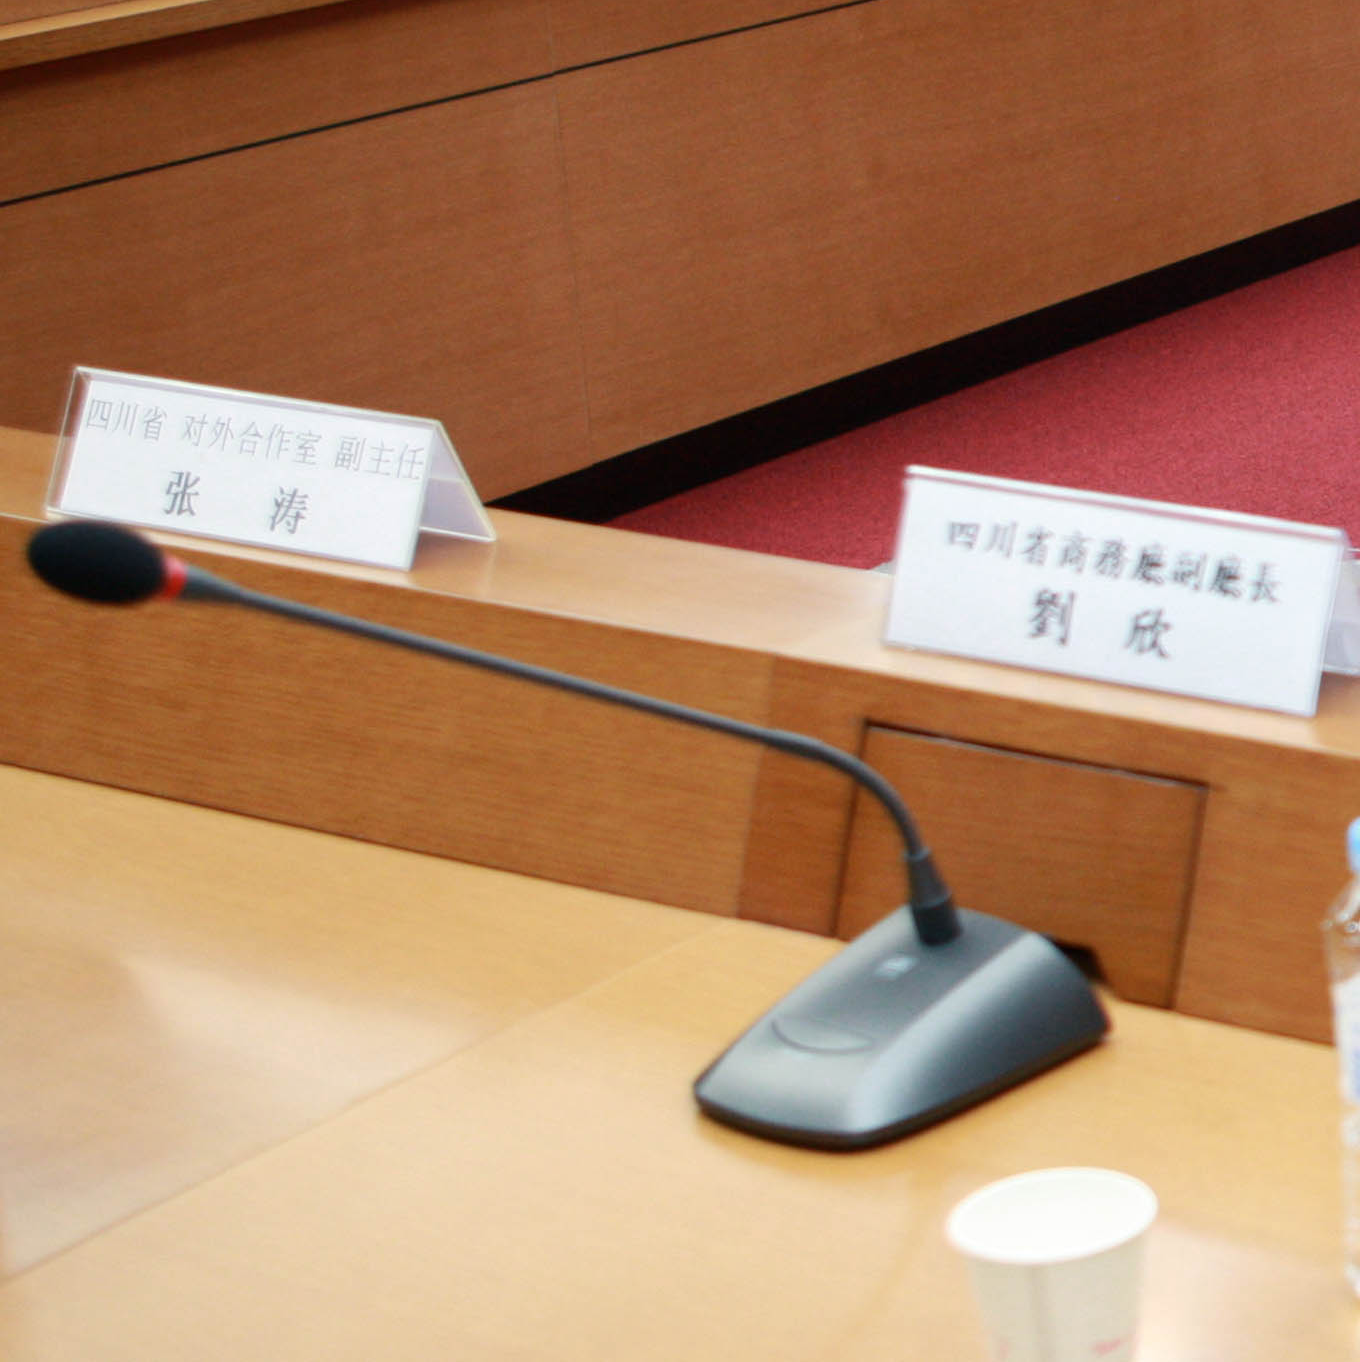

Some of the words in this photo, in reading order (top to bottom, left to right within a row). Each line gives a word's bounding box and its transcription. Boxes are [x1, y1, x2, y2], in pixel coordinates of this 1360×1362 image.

[84, 398, 168, 442] 四川省
[180, 412, 322, 467] 对外合作室
[333, 436, 425, 481] 副主任
[164, 471, 202, 518] 张
[269, 486, 309, 535] 涛
